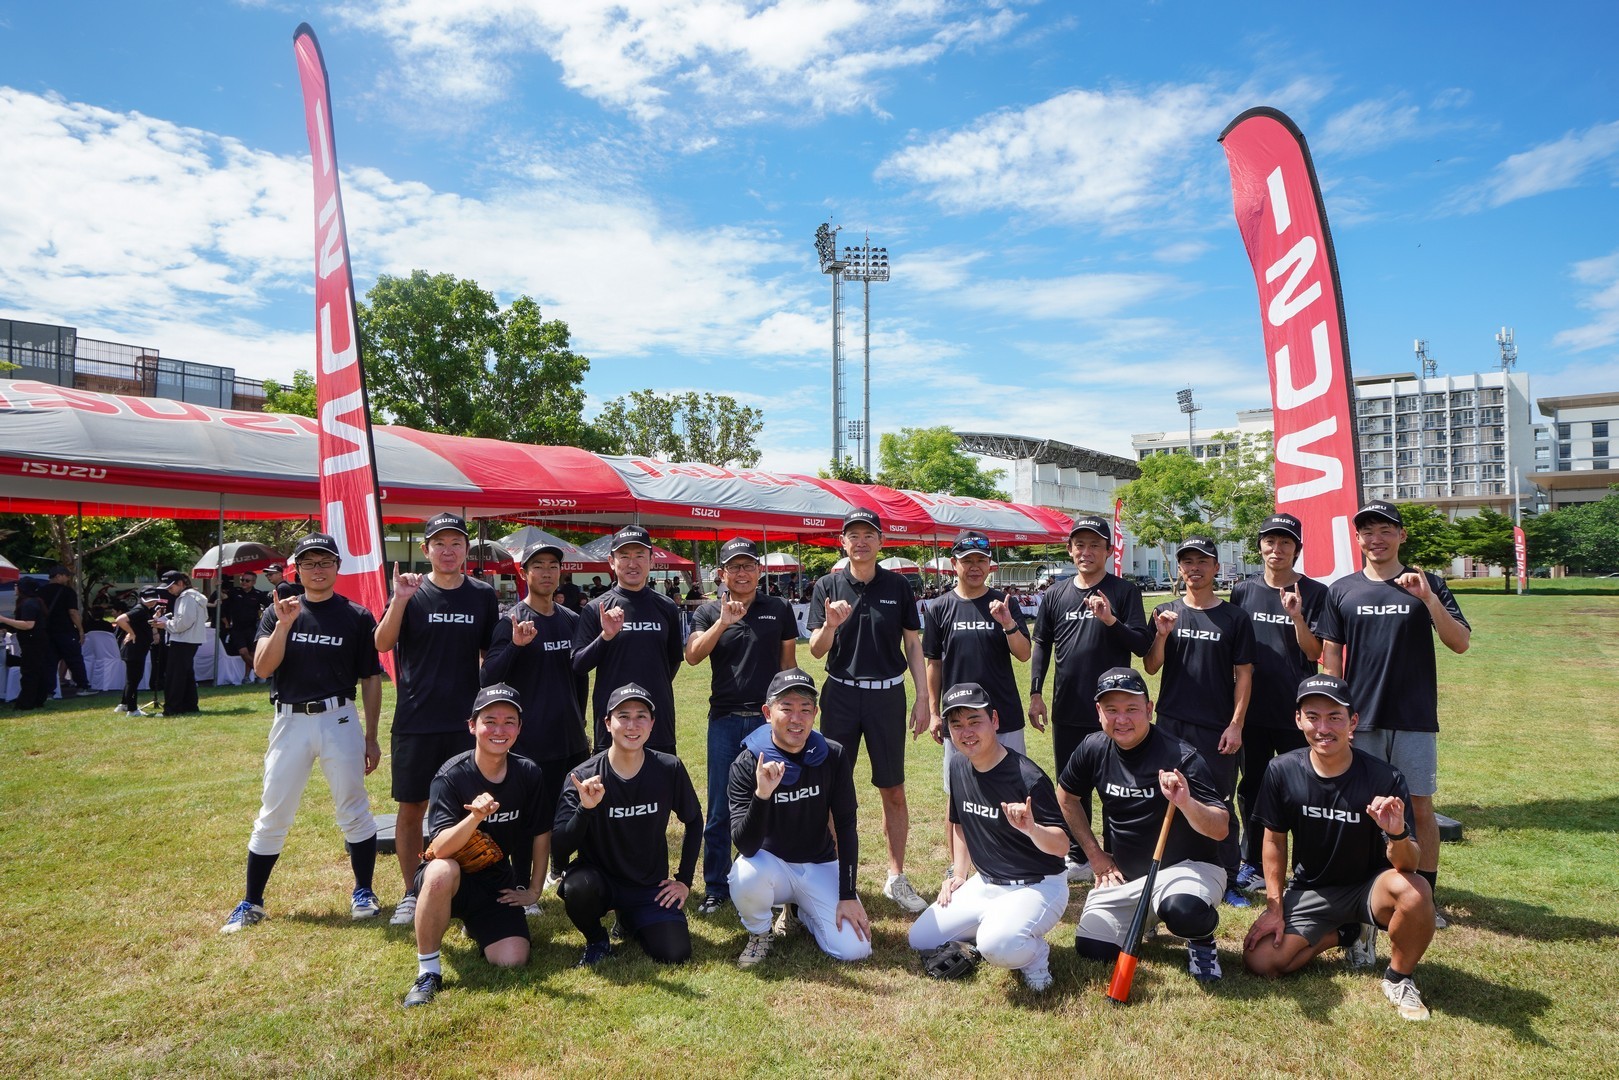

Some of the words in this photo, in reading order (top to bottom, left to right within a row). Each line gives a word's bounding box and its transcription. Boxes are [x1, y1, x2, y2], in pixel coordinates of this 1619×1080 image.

[0, 382, 318, 434] SUZ
[21, 461, 107, 479] ISUZU
[538, 498, 577, 507] ISUZU
[691, 507, 721, 518] ISUZU
[850, 511, 873, 519] ISUZU
[803, 518, 826, 527] ISUZU
[1272, 518, 1296, 526] ISUZU
[889, 524, 908, 532] ISUZU
[728, 541, 750, 550] ISUZU
[1183, 539, 1206, 548] ISUZU
[560, 562, 583, 571] SUZU
[1357, 605, 1410, 615] ISUZU
[428, 613, 474, 624] ISUZU
[1065, 610, 1097, 621] ISUZ
[620, 621, 662, 631] SUZU
[953, 621, 995, 631] ISUZU
[291, 632, 343, 646] ISUZU
[1177, 628, 1221, 642] ISUZU
[1306, 680, 1338, 688] ISUZU
[486, 689, 514, 697] ISUZU
[620, 688, 646, 696] ISUZU
[947, 689, 973, 702] ISUZU
[774, 785, 820, 804] ISUZU
[1105, 782, 1155, 799] ISUZU
[609, 802, 658, 818] ISUZU
[962, 801, 999, 819] ISUZU
[1302, 805, 1361, 824] ISUZU
[484, 809, 520, 824] UZU
